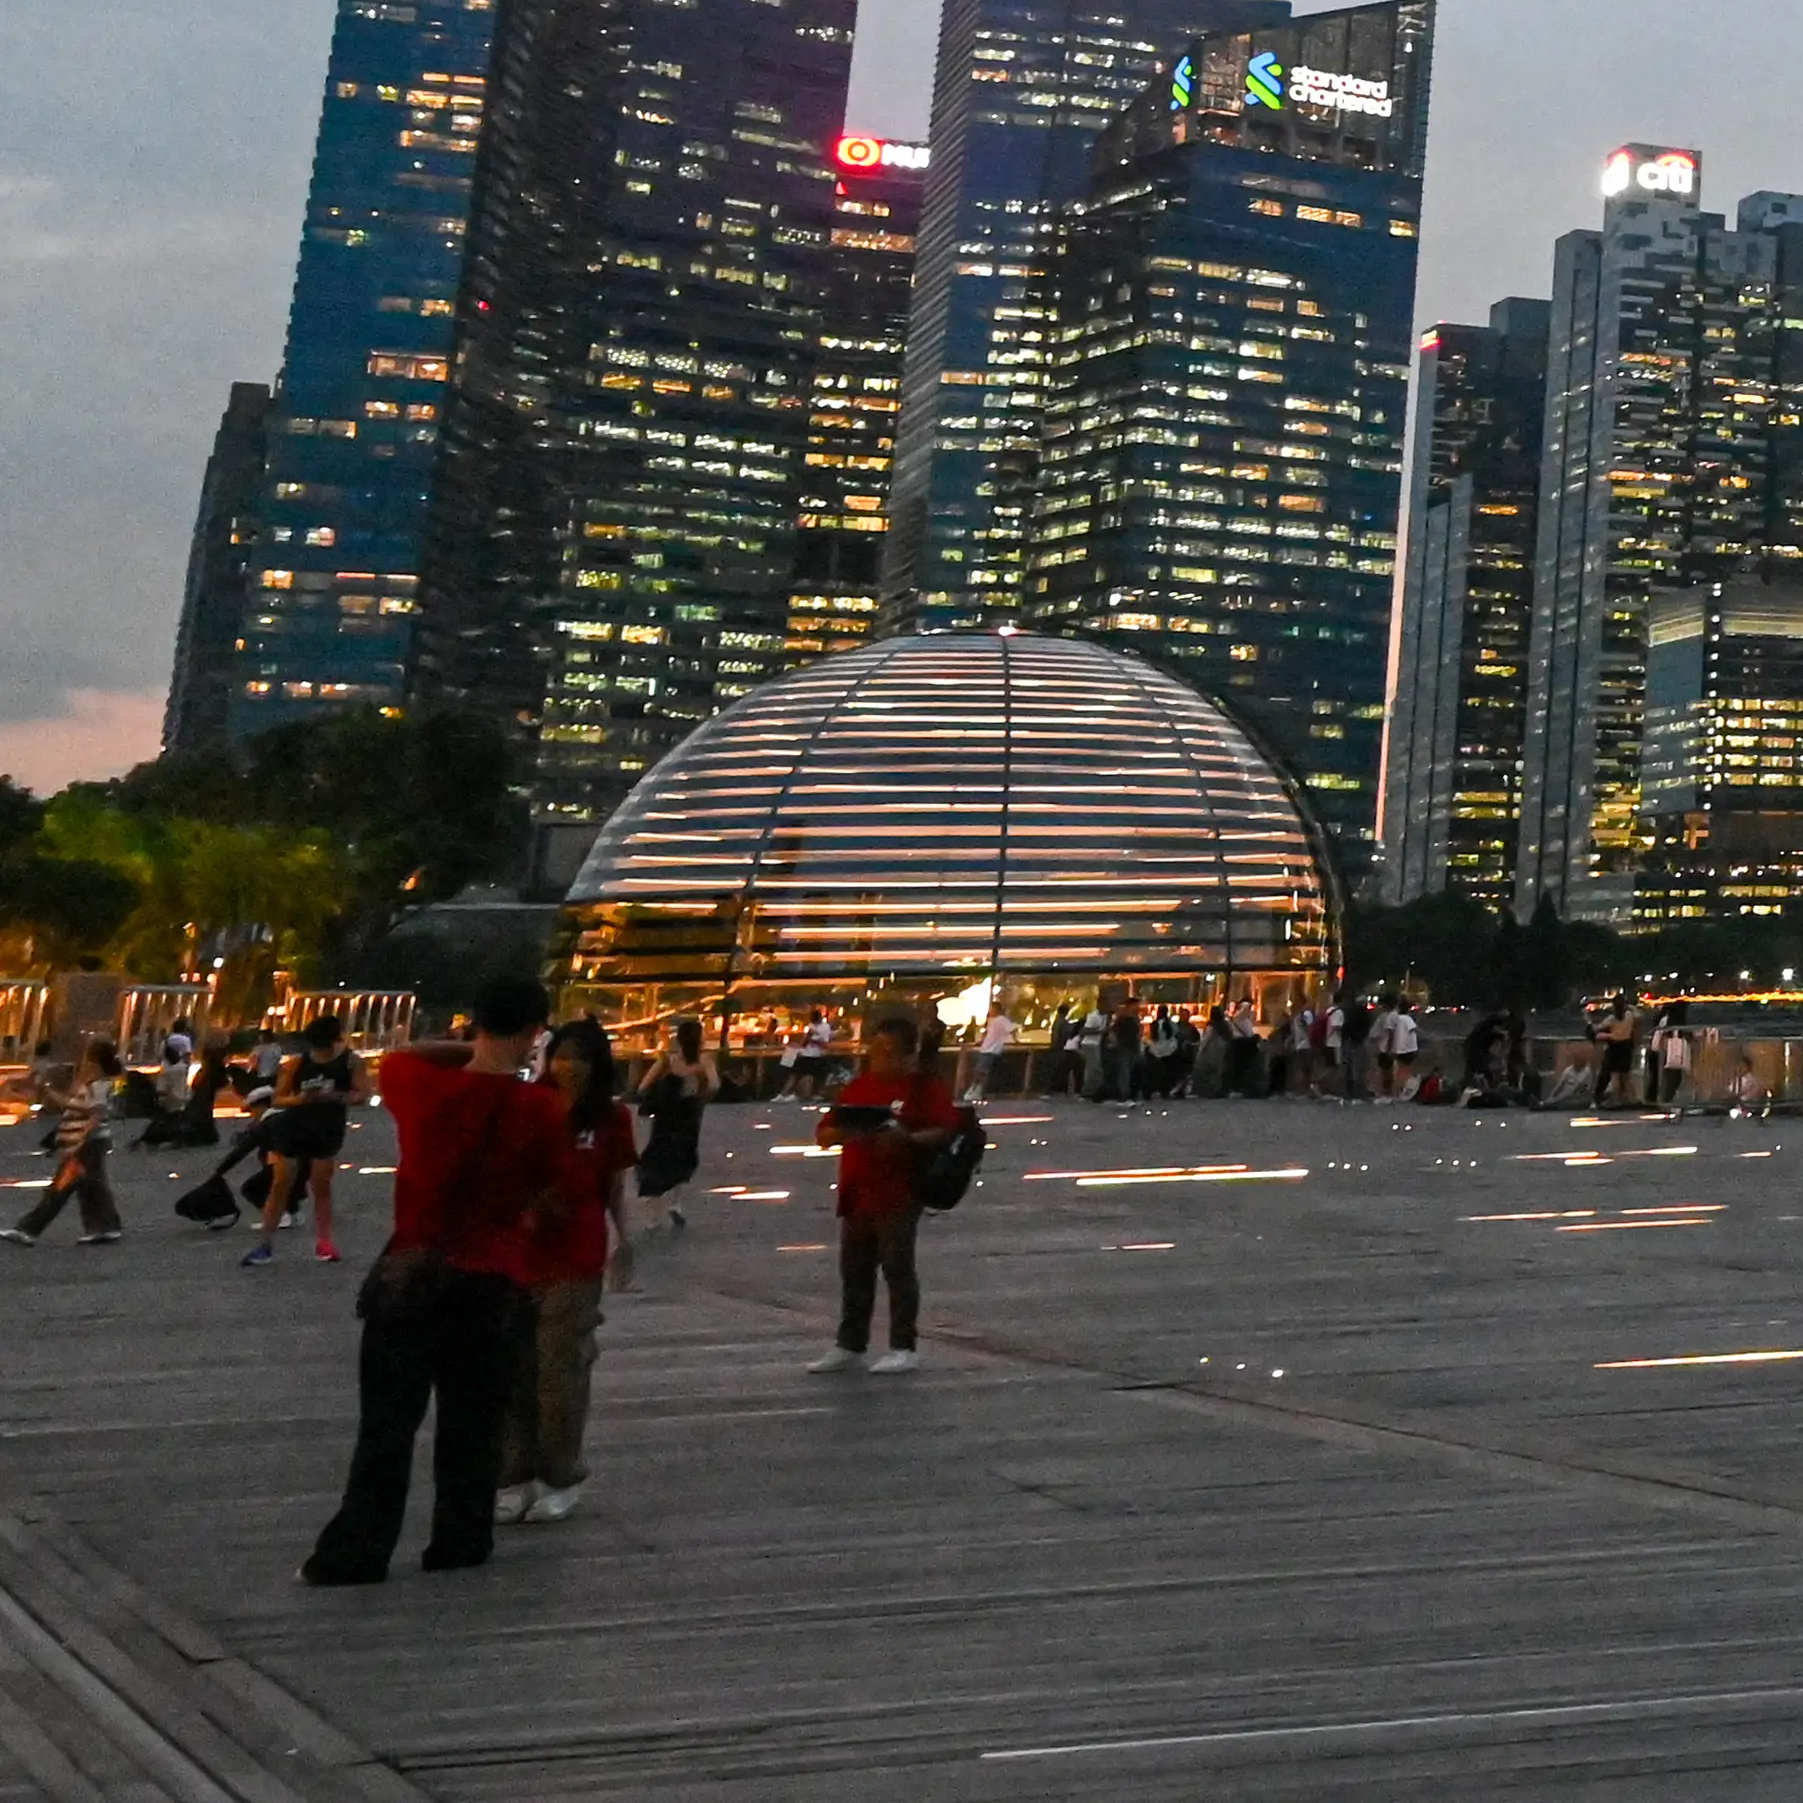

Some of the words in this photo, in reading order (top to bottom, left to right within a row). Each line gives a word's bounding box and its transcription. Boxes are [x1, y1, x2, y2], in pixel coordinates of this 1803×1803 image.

[1290, 65, 1388, 99] standard
[1289, 84, 1392, 117] chartered
[1636, 161, 1693, 194] citi
